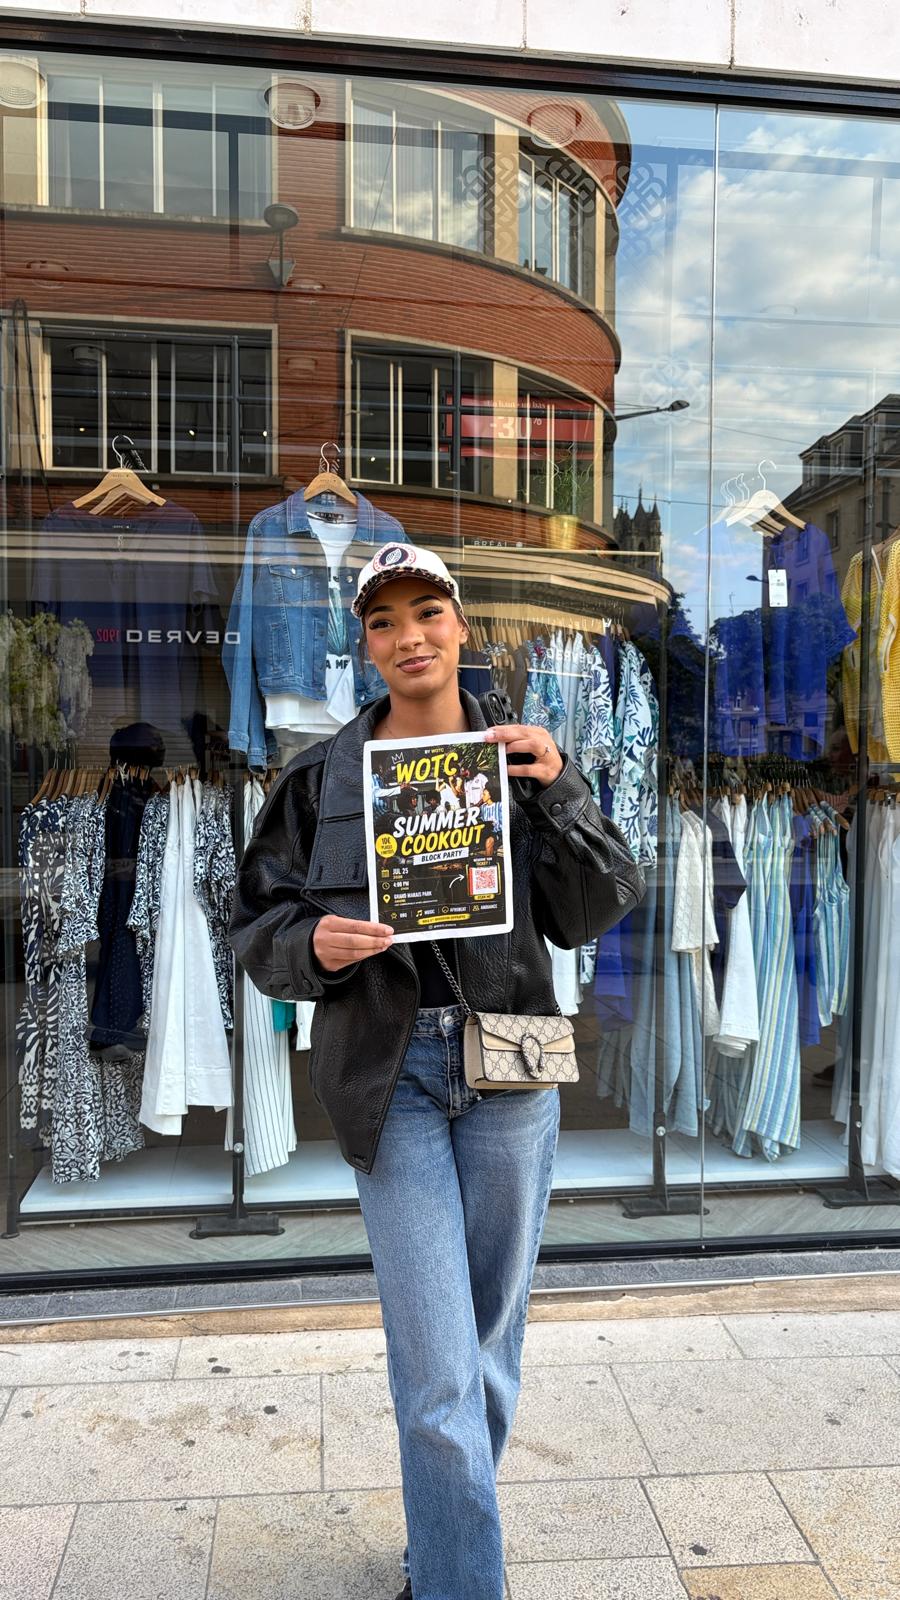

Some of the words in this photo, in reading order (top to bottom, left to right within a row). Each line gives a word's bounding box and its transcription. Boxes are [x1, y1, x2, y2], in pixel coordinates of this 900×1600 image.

[396, 752, 459, 784] WOTC
[393, 807, 480, 838] SUMMER
[401, 824, 485, 856] COOKOUT
[402, 867, 409, 875] 25
[421, 853, 441, 863] BLOCK
[442, 850, 463, 859] PARTY
